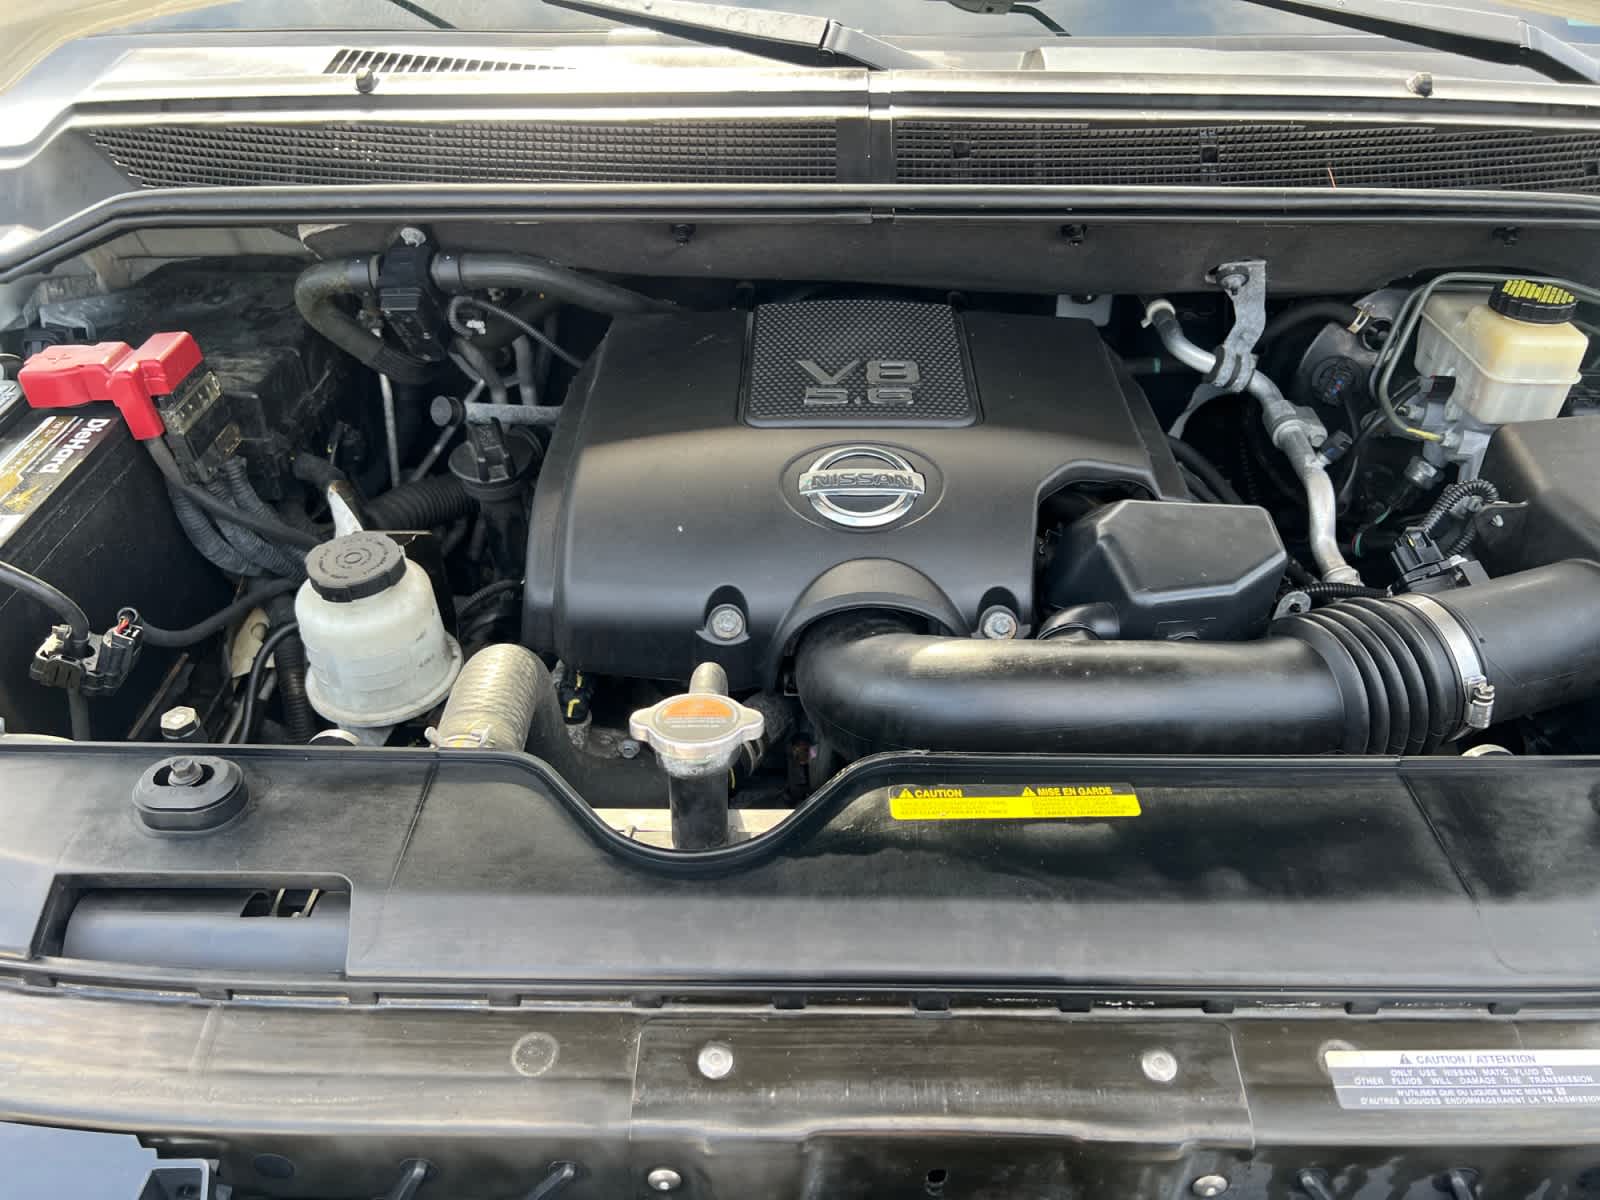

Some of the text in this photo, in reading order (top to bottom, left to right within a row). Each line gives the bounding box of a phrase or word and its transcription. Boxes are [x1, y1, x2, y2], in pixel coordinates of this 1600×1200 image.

[796, 359, 921, 385] V8
[803, 387, 914, 405] 5.6
[39, 418, 111, 473] DieHard
[811, 473, 913, 487] NISSAN
[914, 788, 963, 799] CAUTION
[1037, 785, 1113, 797] MISE EN GARDE
[1416, 1055, 1466, 1065] CAUTION
[1475, 1054, 1537, 1064] ATTENTION
[1390, 1068, 1413, 1077] ONLY
[1419, 1068, 1438, 1077] USE
[1443, 1068, 1477, 1077] NISSAN
[1482, 1068, 1509, 1076] MATIC
[1513, 1068, 1539, 1076] FLUID
[1354, 1076, 1385, 1085] OTHER
[1391, 1076, 1423, 1085] FLUIDS
[1430, 1076, 1453, 1085] WILL
[1459, 1076, 1497, 1085] DAMAGE
[1503, 1076, 1521, 1084] THE
[1527, 1096, 1540, 1104] LA
